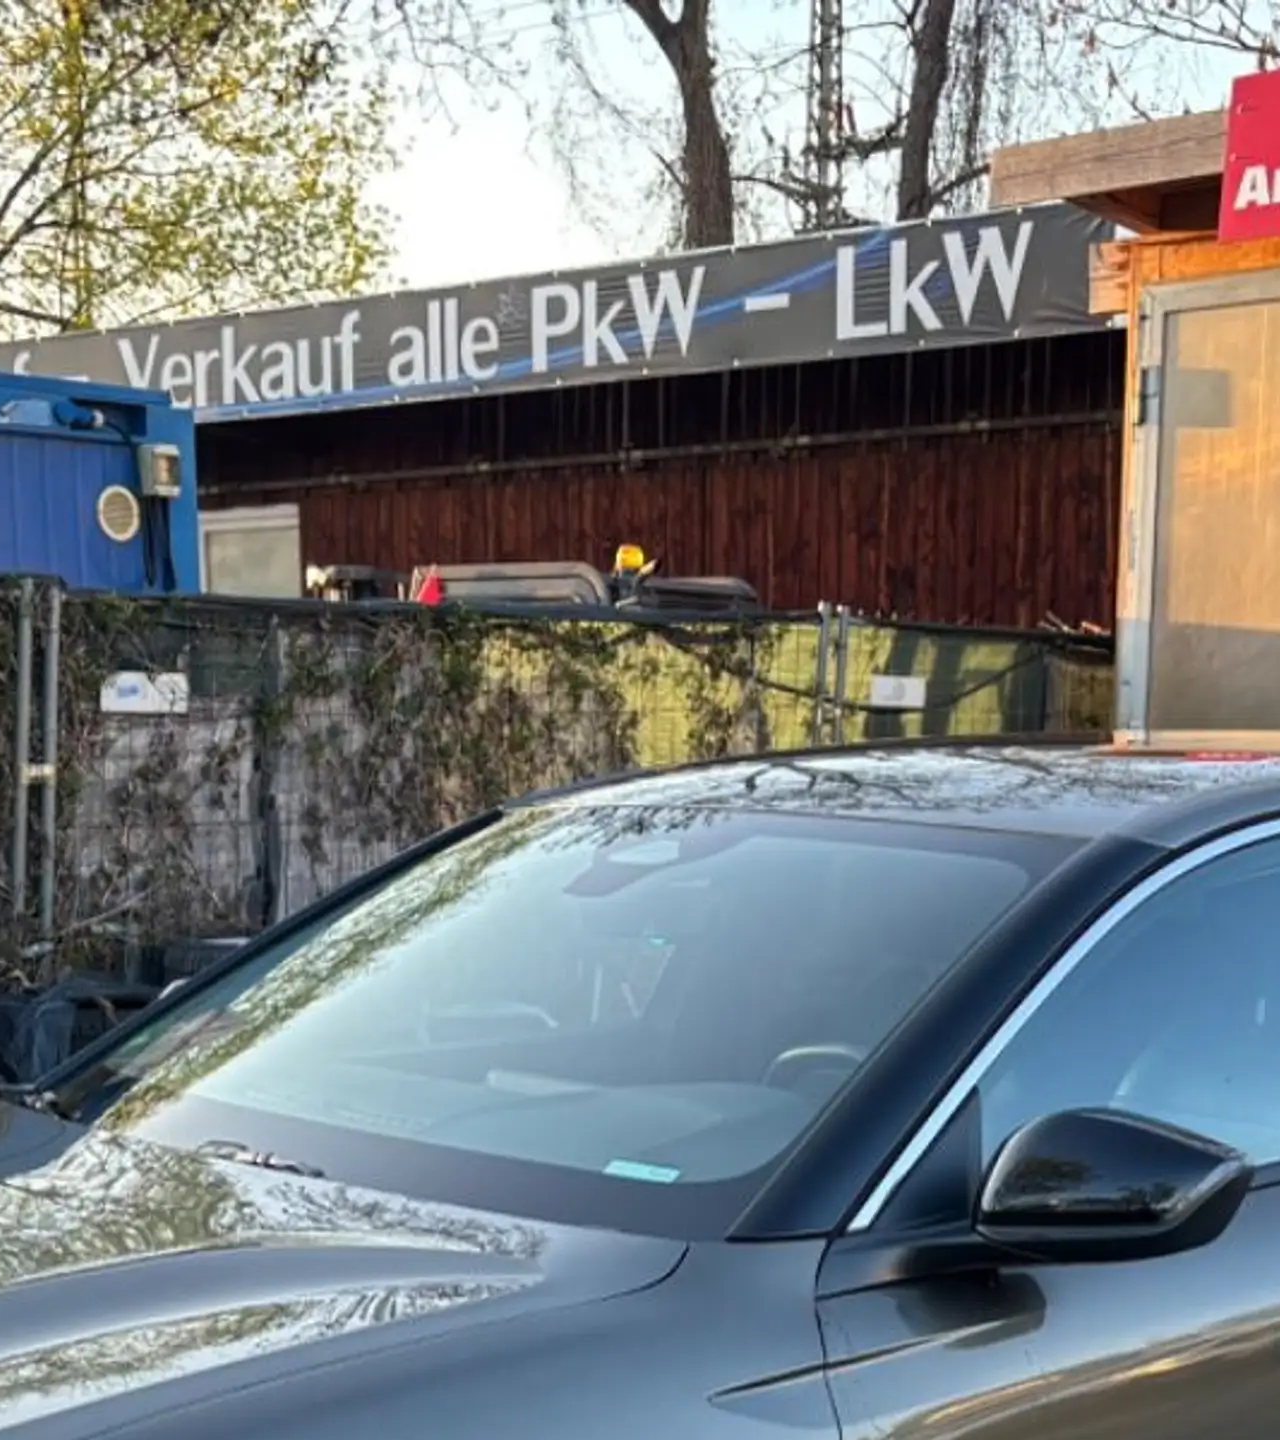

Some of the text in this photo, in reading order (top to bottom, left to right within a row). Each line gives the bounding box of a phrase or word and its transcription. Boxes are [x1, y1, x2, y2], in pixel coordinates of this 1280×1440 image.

[118, 310, 362, 409] Verkauf
[387, 297, 500, 387] alle
[530, 265, 707, 374] PkW
[836, 220, 1036, 341] LkW
